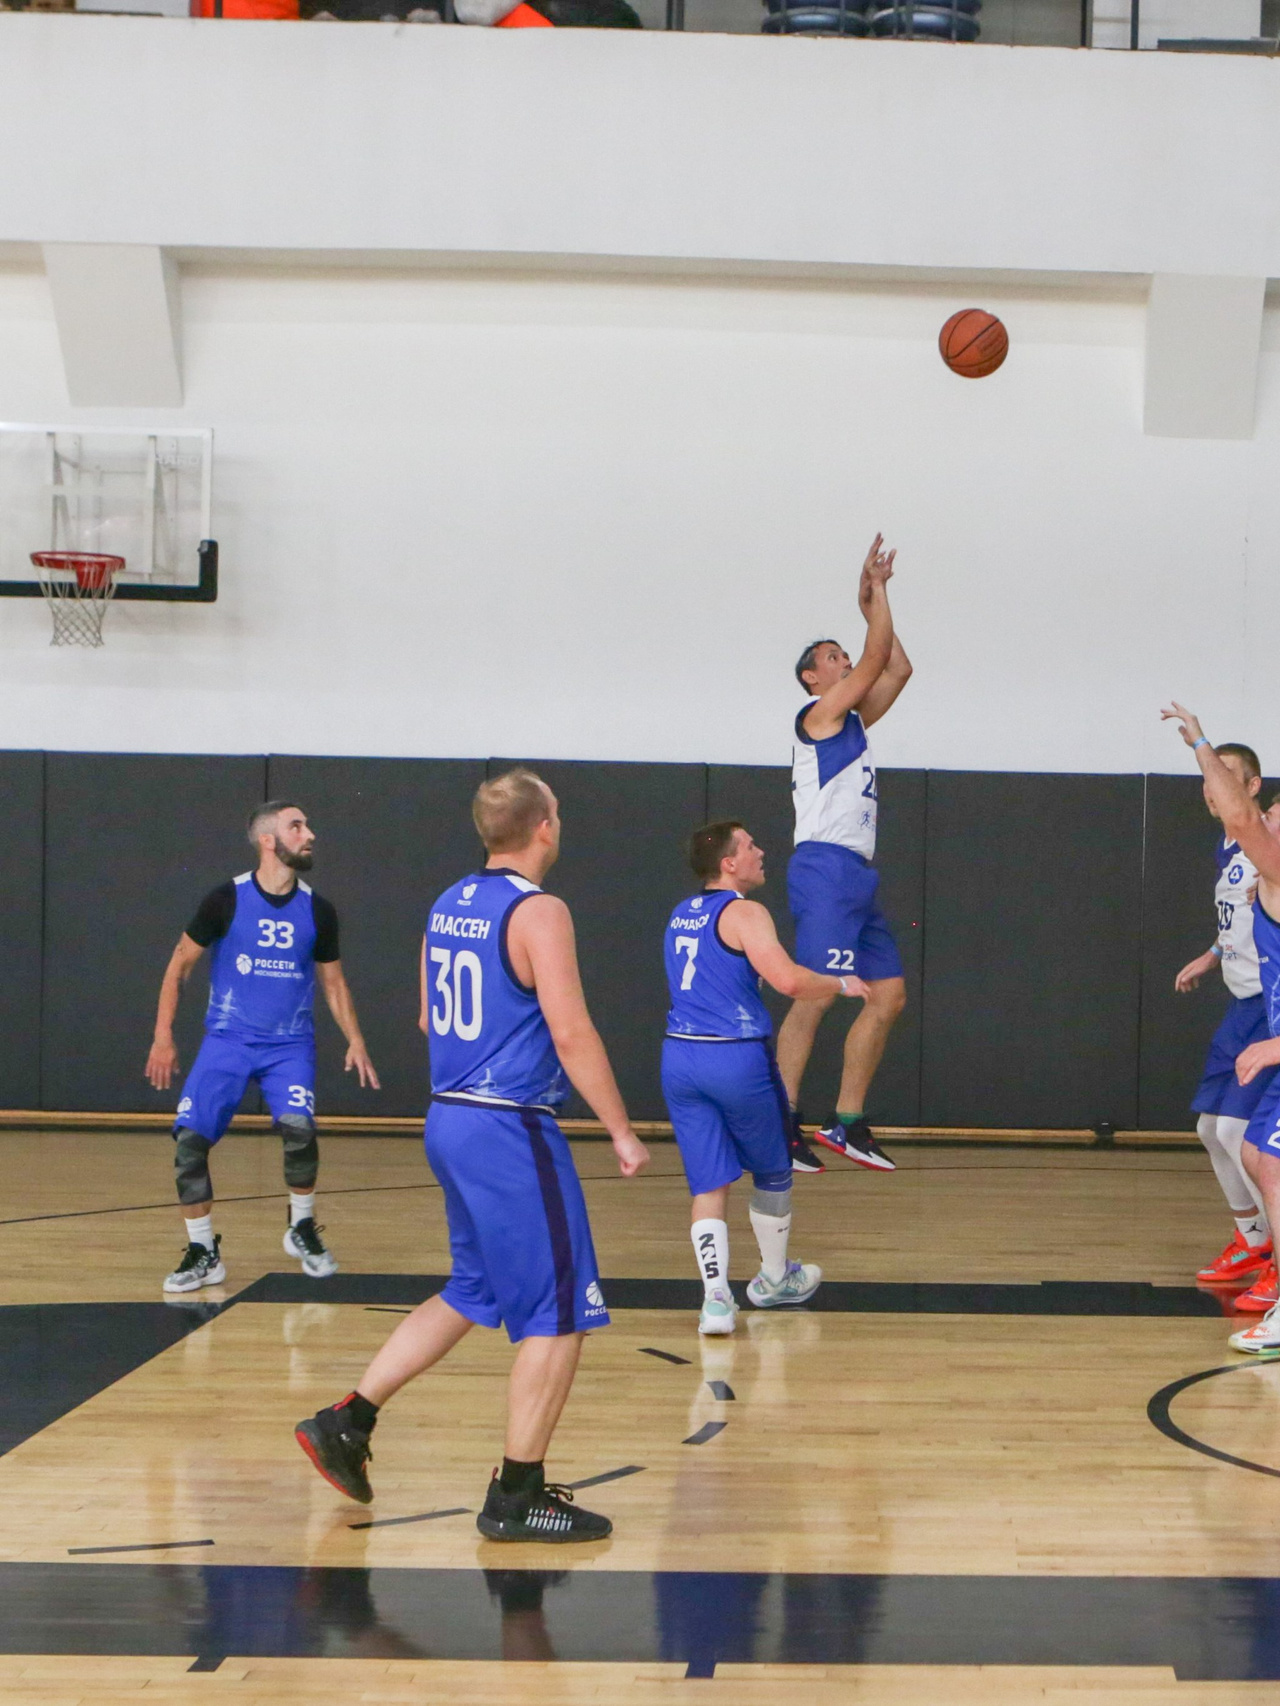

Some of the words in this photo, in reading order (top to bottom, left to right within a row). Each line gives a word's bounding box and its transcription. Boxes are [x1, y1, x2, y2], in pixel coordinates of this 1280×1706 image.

[257, 918, 295, 949] 33
[430, 913, 492, 940] КЛАССЕН
[255, 958, 295, 970] РОССЕТИ
[675, 935, 699, 991] 7
[826, 949, 855, 970] 22
[430, 946, 483, 1041] 30
